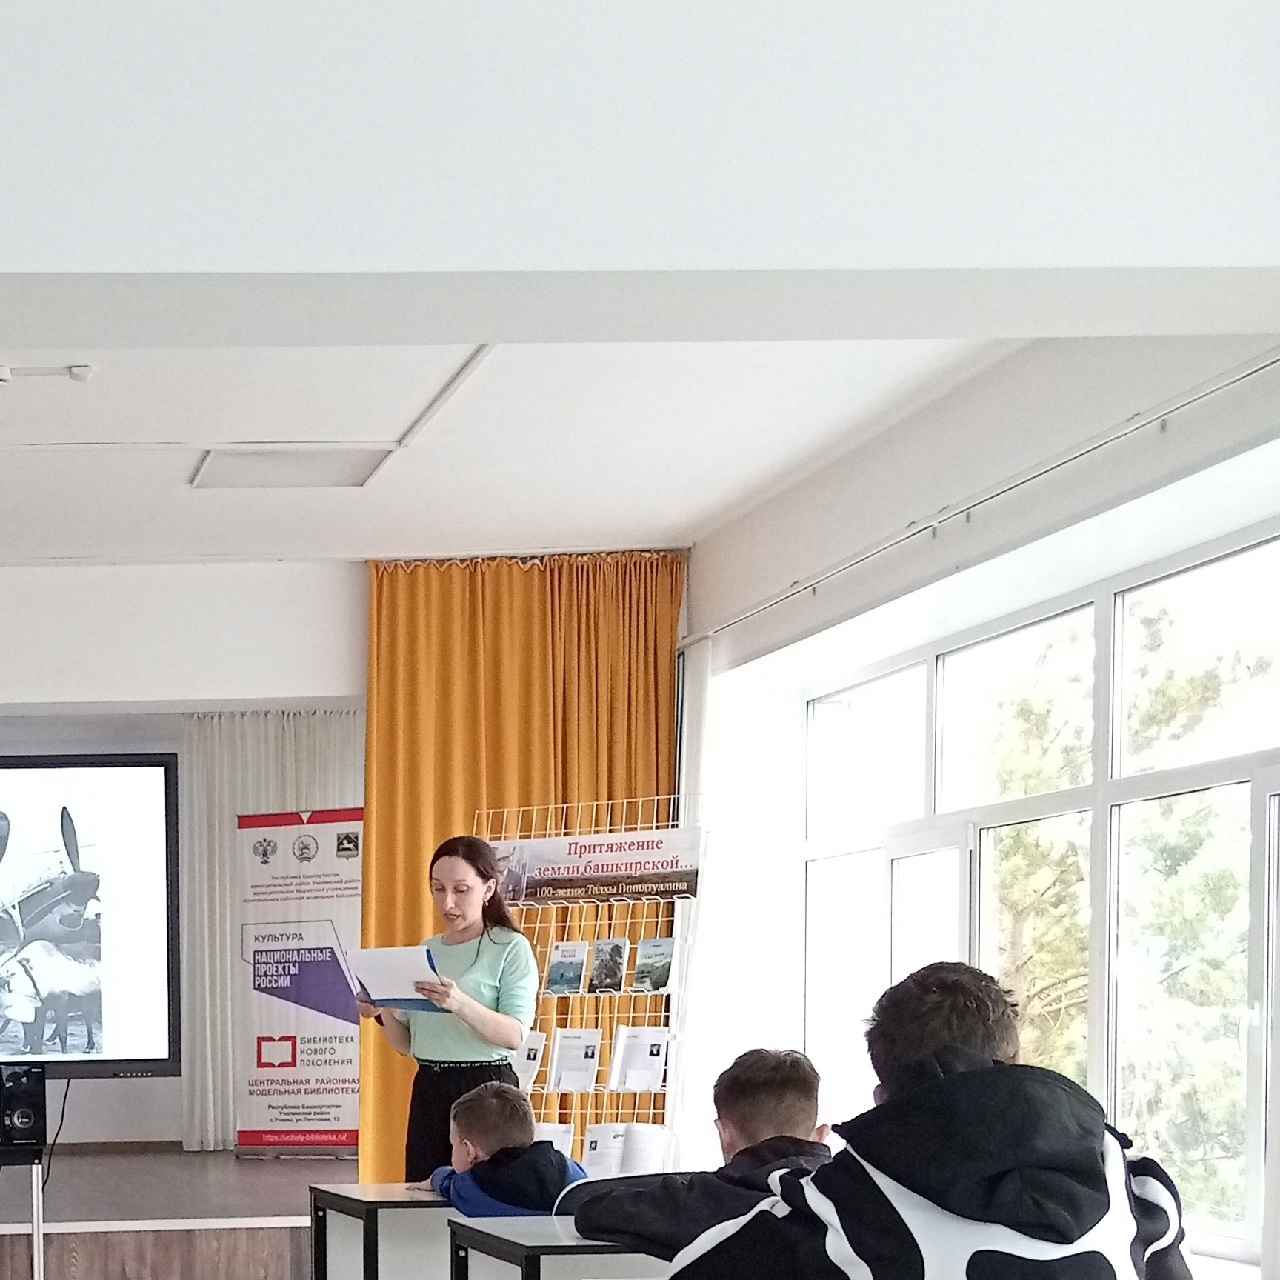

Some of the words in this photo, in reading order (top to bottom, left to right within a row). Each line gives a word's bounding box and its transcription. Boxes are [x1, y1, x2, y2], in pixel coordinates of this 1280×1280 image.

[566, 839, 664, 858] Притяжение
[533, 864, 581, 878] земли
[254, 933, 304, 943] КУЛЬТУРА
[255, 949, 332, 963] НАЦИОНАЛЬНЫЕ
[255, 963, 299, 975] ПРОЕКТЫ
[255, 976, 291, 988] РОССИИ
[300, 1035, 354, 1045] БИБЛИОТЕКА
[300, 1047, 336, 1056] НОВОГО
[300, 1058, 353, 1067] ПОКОЛЕНИЯ
[248, 1079, 311, 1087] ЦЕНТРАЛЬНАЯ
[248, 1088, 302, 1096] МОДЕЛЬНАЯ
